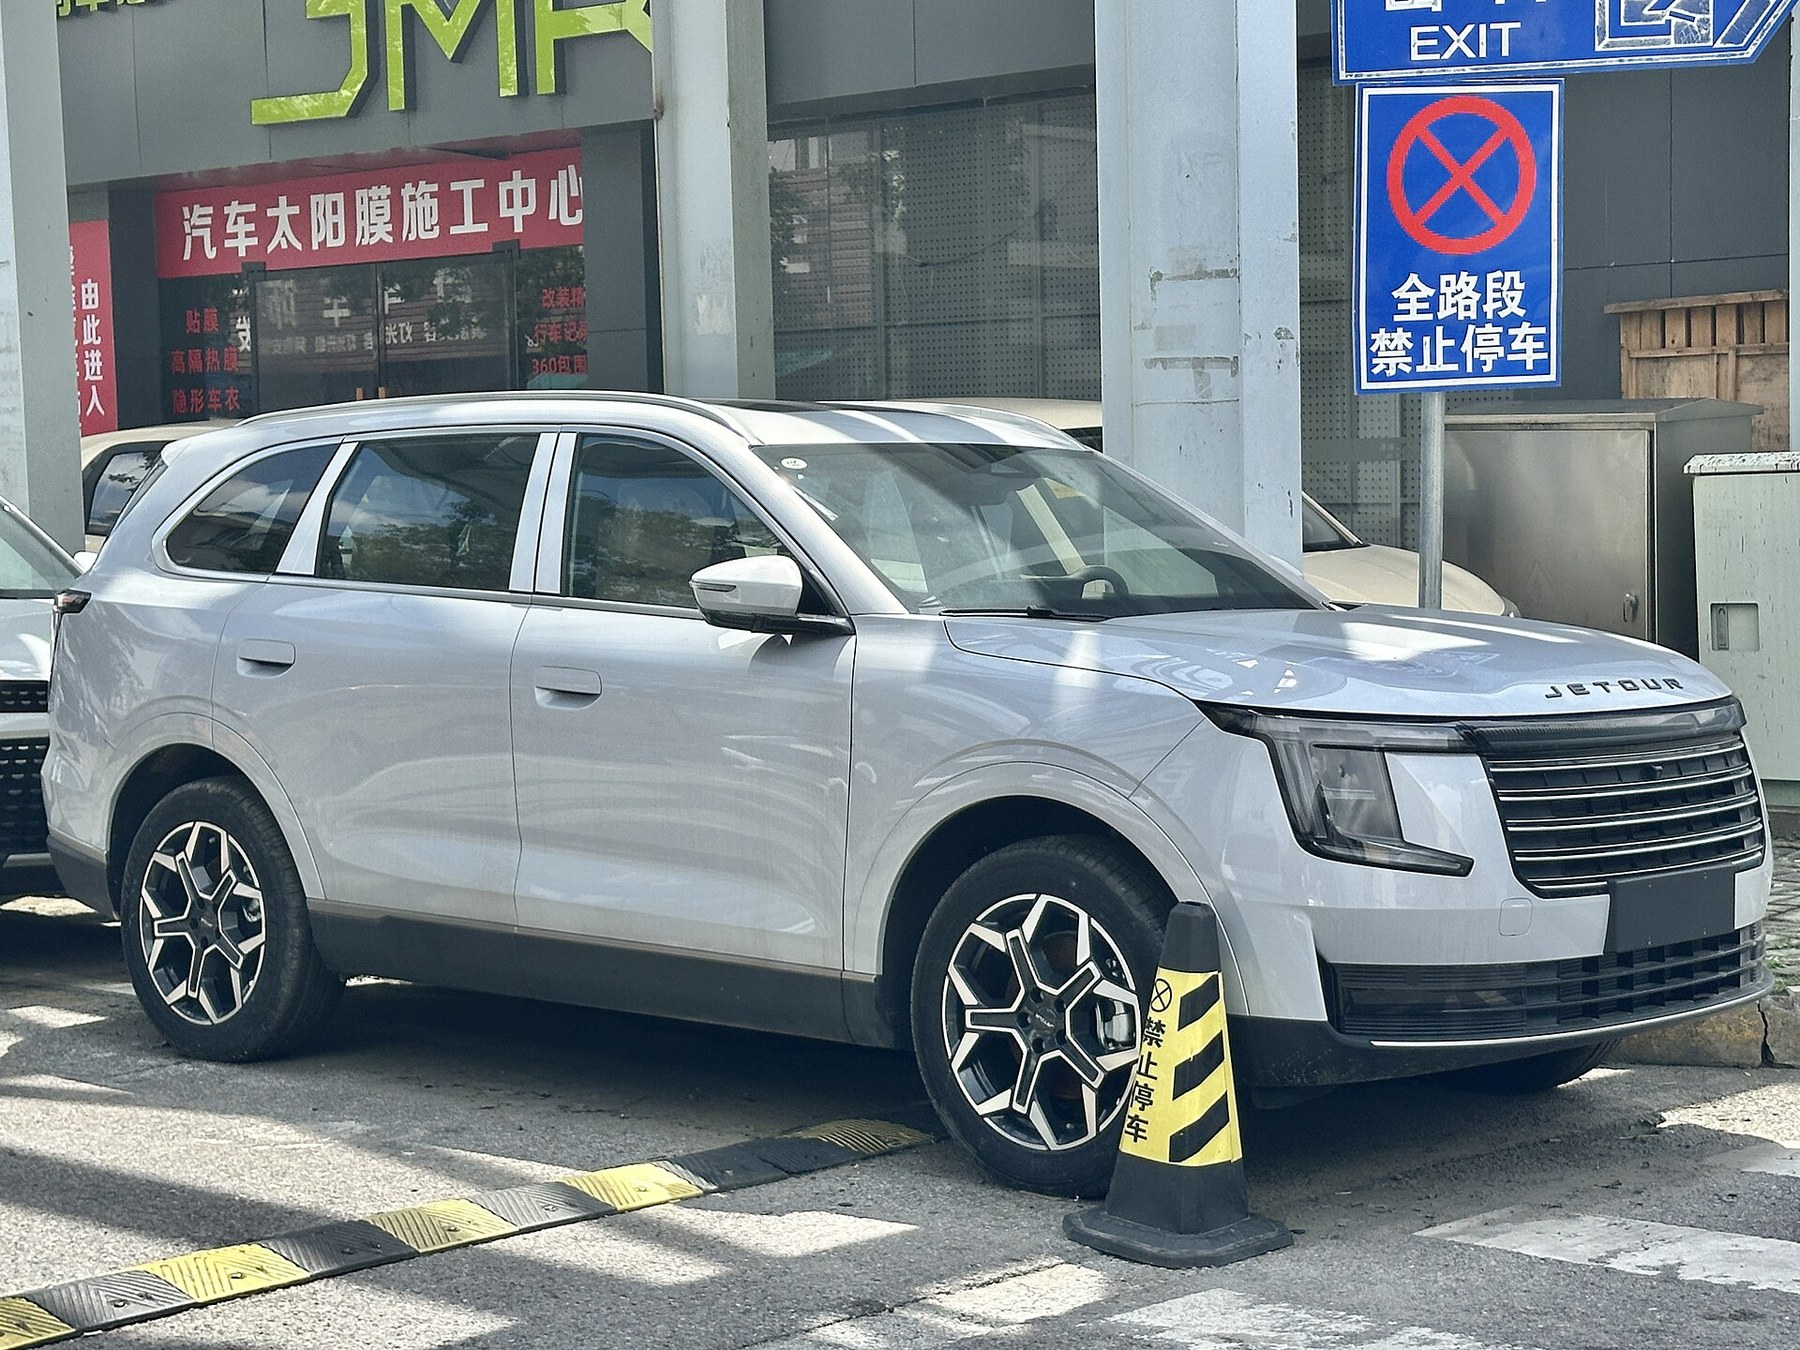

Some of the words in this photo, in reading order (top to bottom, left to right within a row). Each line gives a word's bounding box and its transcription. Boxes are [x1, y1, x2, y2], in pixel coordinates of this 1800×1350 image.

[1410, 22, 1521, 61] EXIT
[182, 164, 584, 261] 汽车太阳膜施工中心
[1391, 270, 1526, 322] 全路段
[1370, 322, 1549, 376] 禁止停车
[1545, 678, 1684, 699] JETOUR
[1124, 1016, 1167, 1143] 禁止停车
